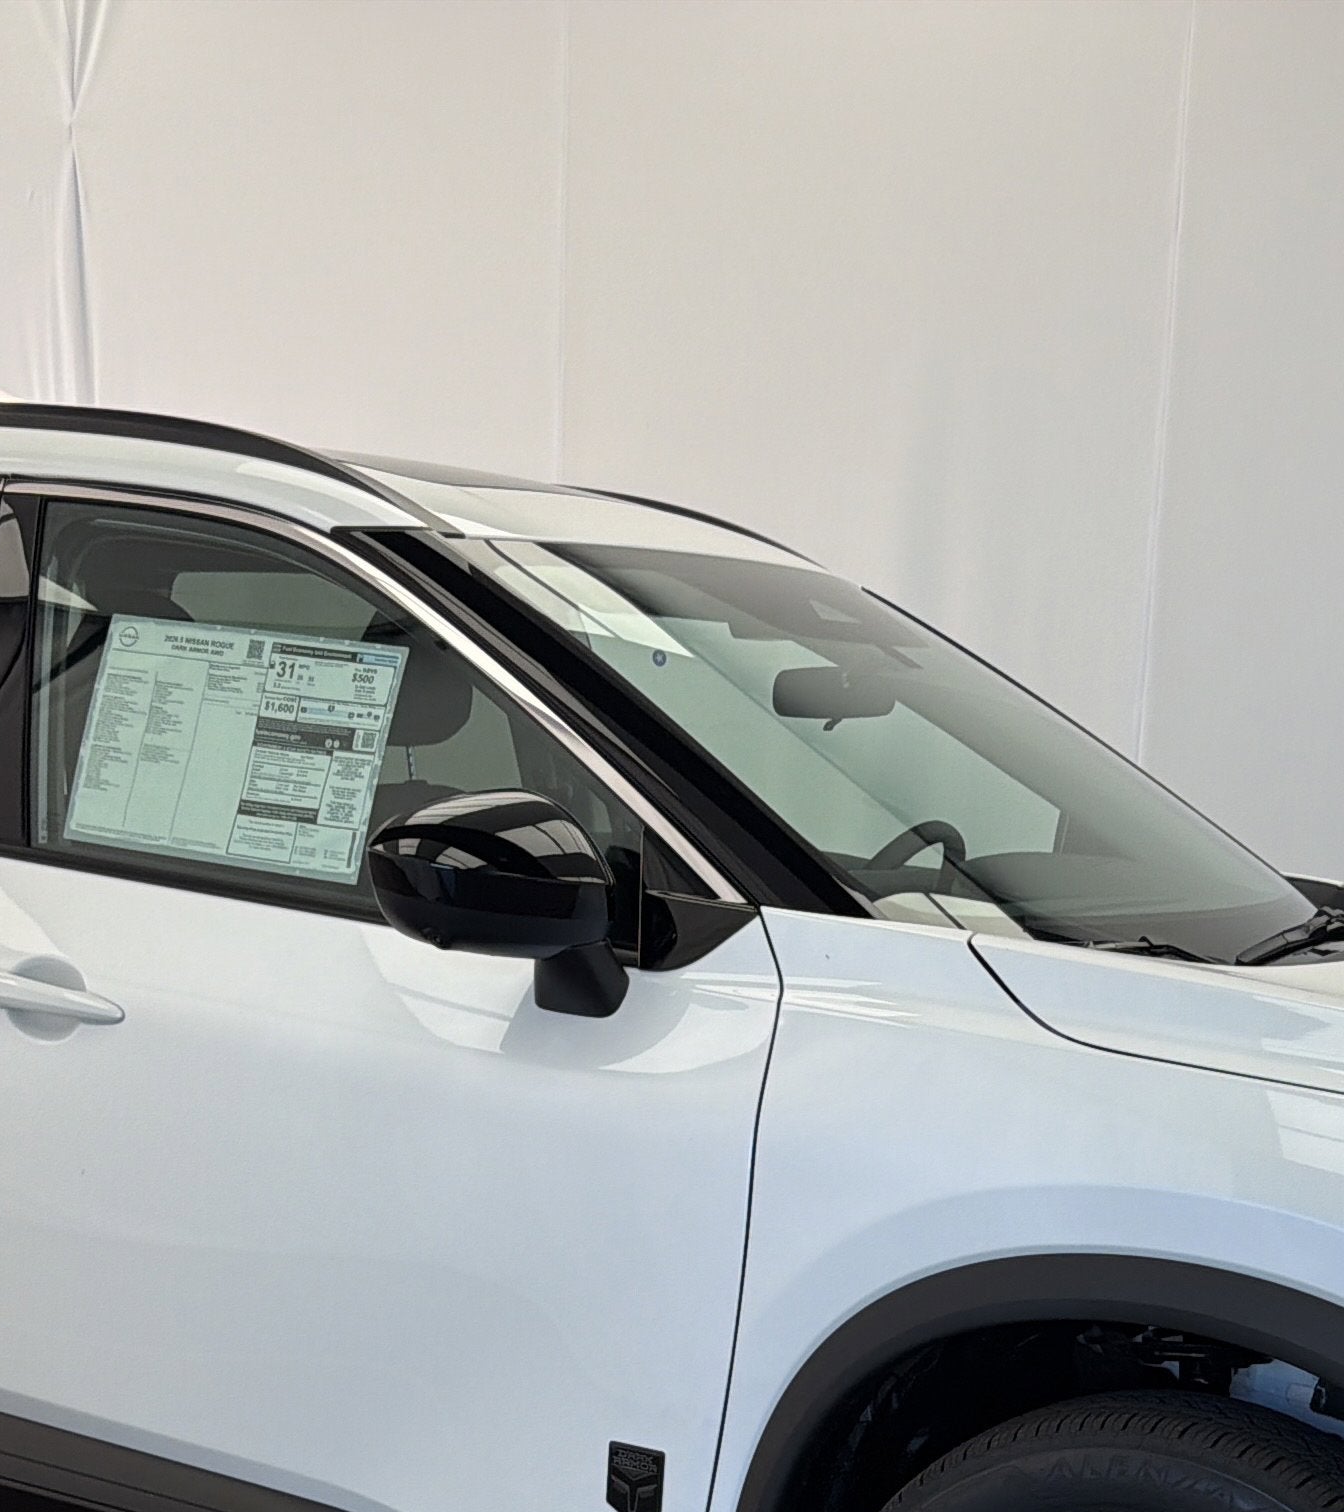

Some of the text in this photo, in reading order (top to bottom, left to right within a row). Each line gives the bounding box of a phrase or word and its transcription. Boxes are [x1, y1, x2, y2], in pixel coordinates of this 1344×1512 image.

[211, 639, 234, 650] ROGUE
[276, 661, 296, 679] 31
[351, 673, 375, 684] $500
[264, 700, 295, 714] $1,600
[612, 1455, 658, 1473] ARMOR
